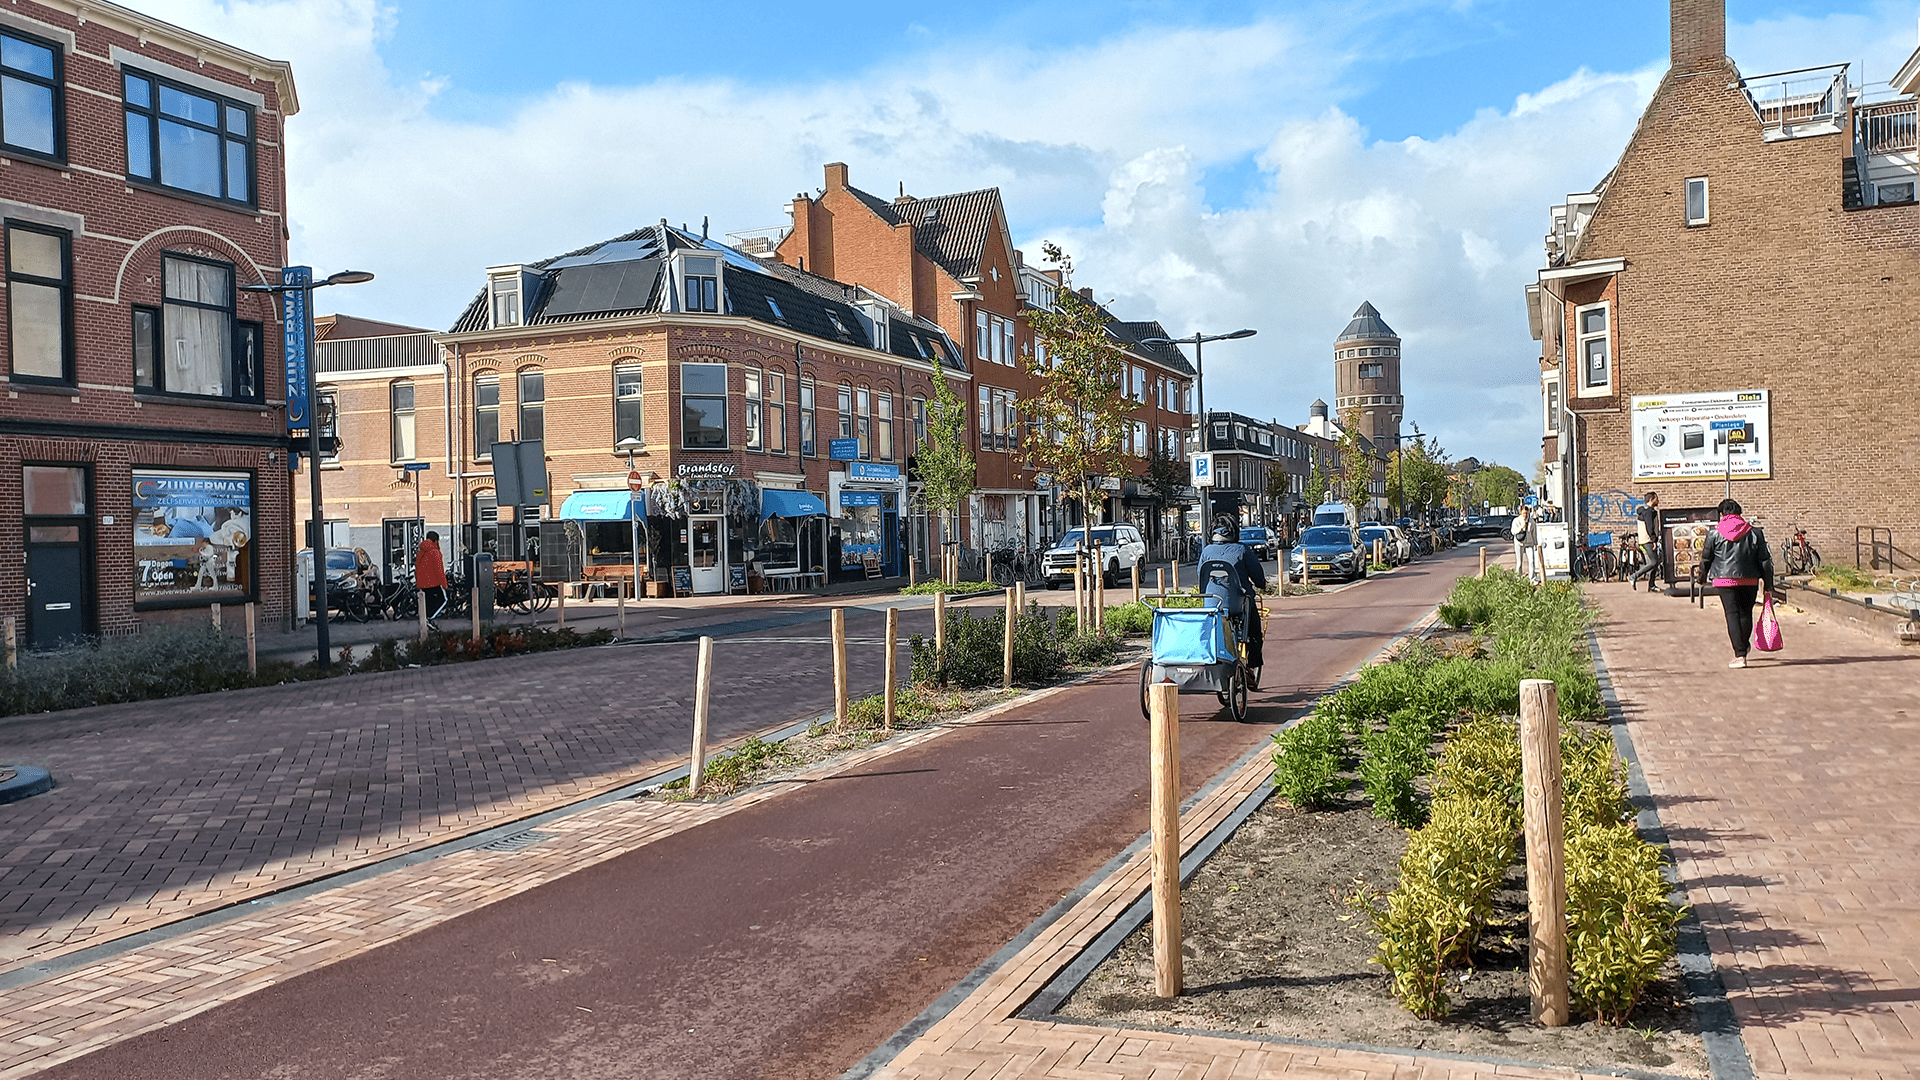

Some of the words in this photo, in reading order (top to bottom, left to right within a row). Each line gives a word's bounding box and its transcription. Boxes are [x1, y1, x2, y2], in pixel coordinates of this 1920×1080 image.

[284, 272, 298, 397] ZUIVERWAS
[678, 462, 735, 475] Brandstof
[1198, 460, 1205, 469] P
[157, 480, 246, 492] ZUIVERWAS
[691, 496, 721, 511] 314
[139, 560, 151, 582] 7
[152, 571, 174, 582] Open
